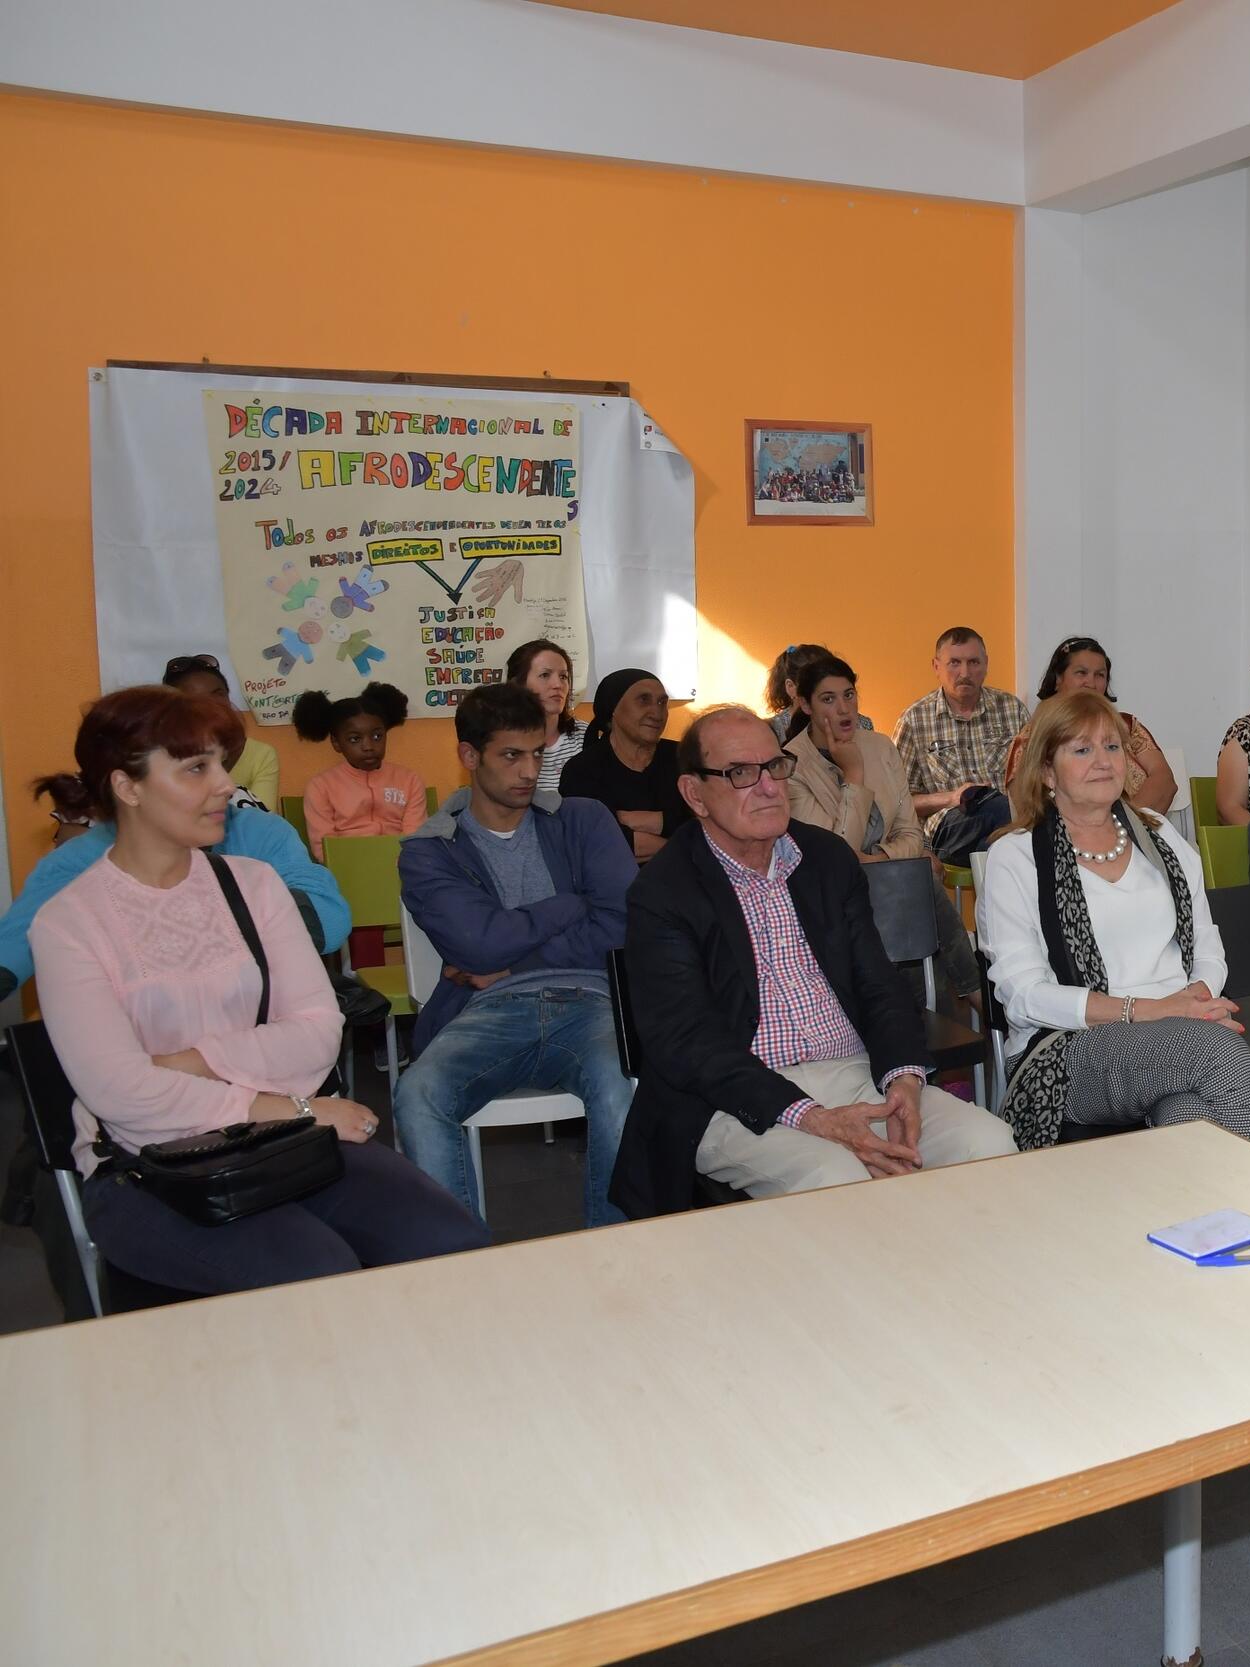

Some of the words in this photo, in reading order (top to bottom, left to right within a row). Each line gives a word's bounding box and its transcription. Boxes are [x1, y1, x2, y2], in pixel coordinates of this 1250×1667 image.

[224, 398, 342, 438] DÉCADA
[355, 410, 544, 435] INTERNACIONAL
[553, 419, 573, 437] DE
[219, 477, 282, 501] 2024
[449, 542, 457, 553] E
[421, 621, 505, 644] EDUCAÇÃO
[426, 645, 485, 664] SAÚDE
[425, 666, 504, 686] EMPREGO
[425, 689, 466, 706] CULT
